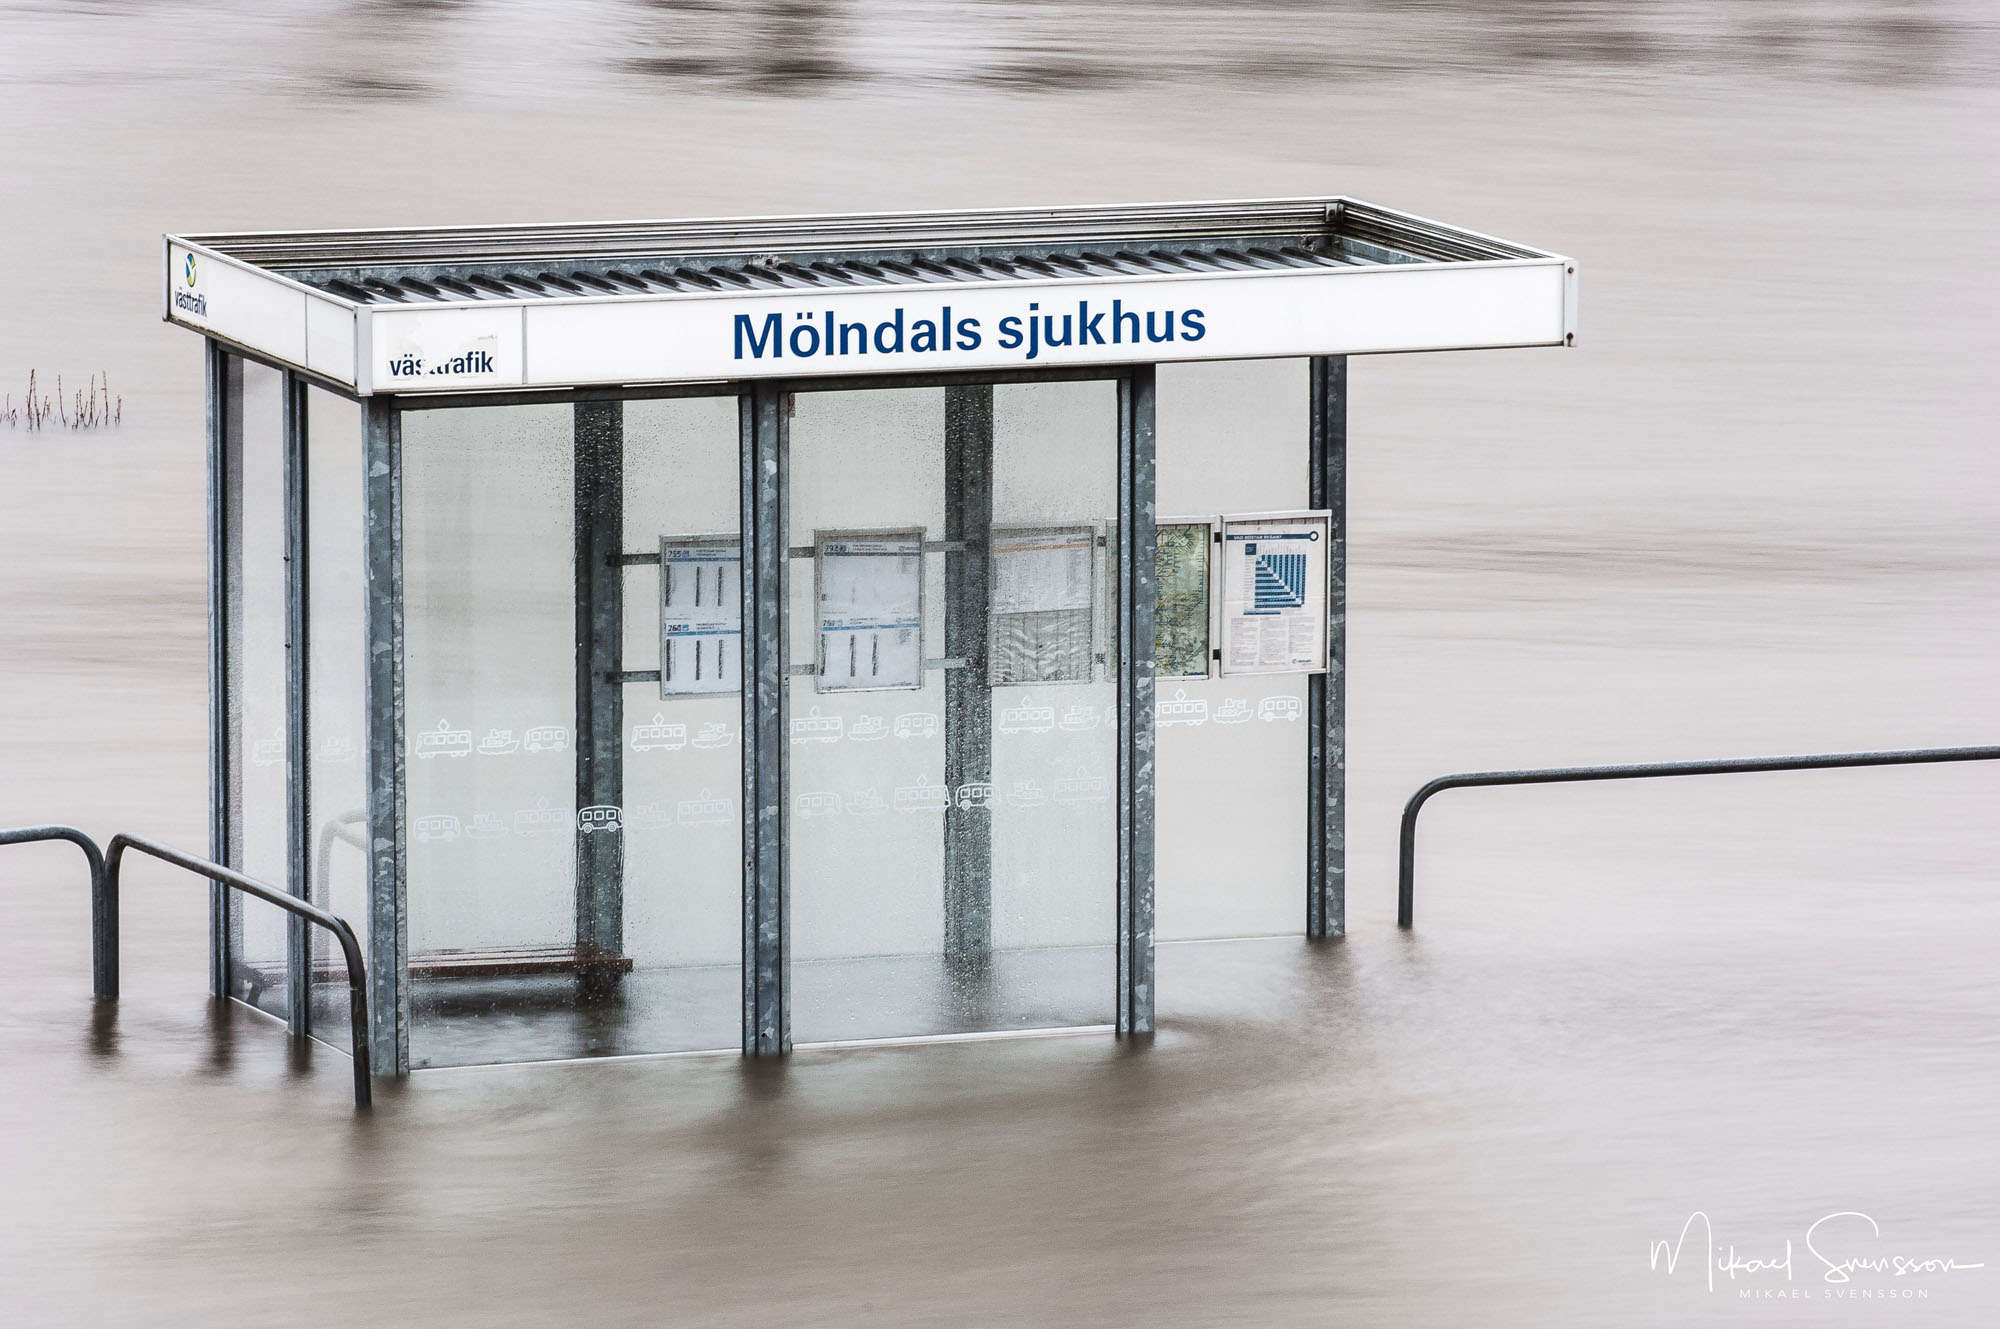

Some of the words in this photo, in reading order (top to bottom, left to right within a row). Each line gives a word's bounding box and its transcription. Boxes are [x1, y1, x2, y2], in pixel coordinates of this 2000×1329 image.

[733, 305, 982, 360] Mölndals
[998, 299, 1207, 360] sjukhus
[389, 350, 494, 376] väsrafik
